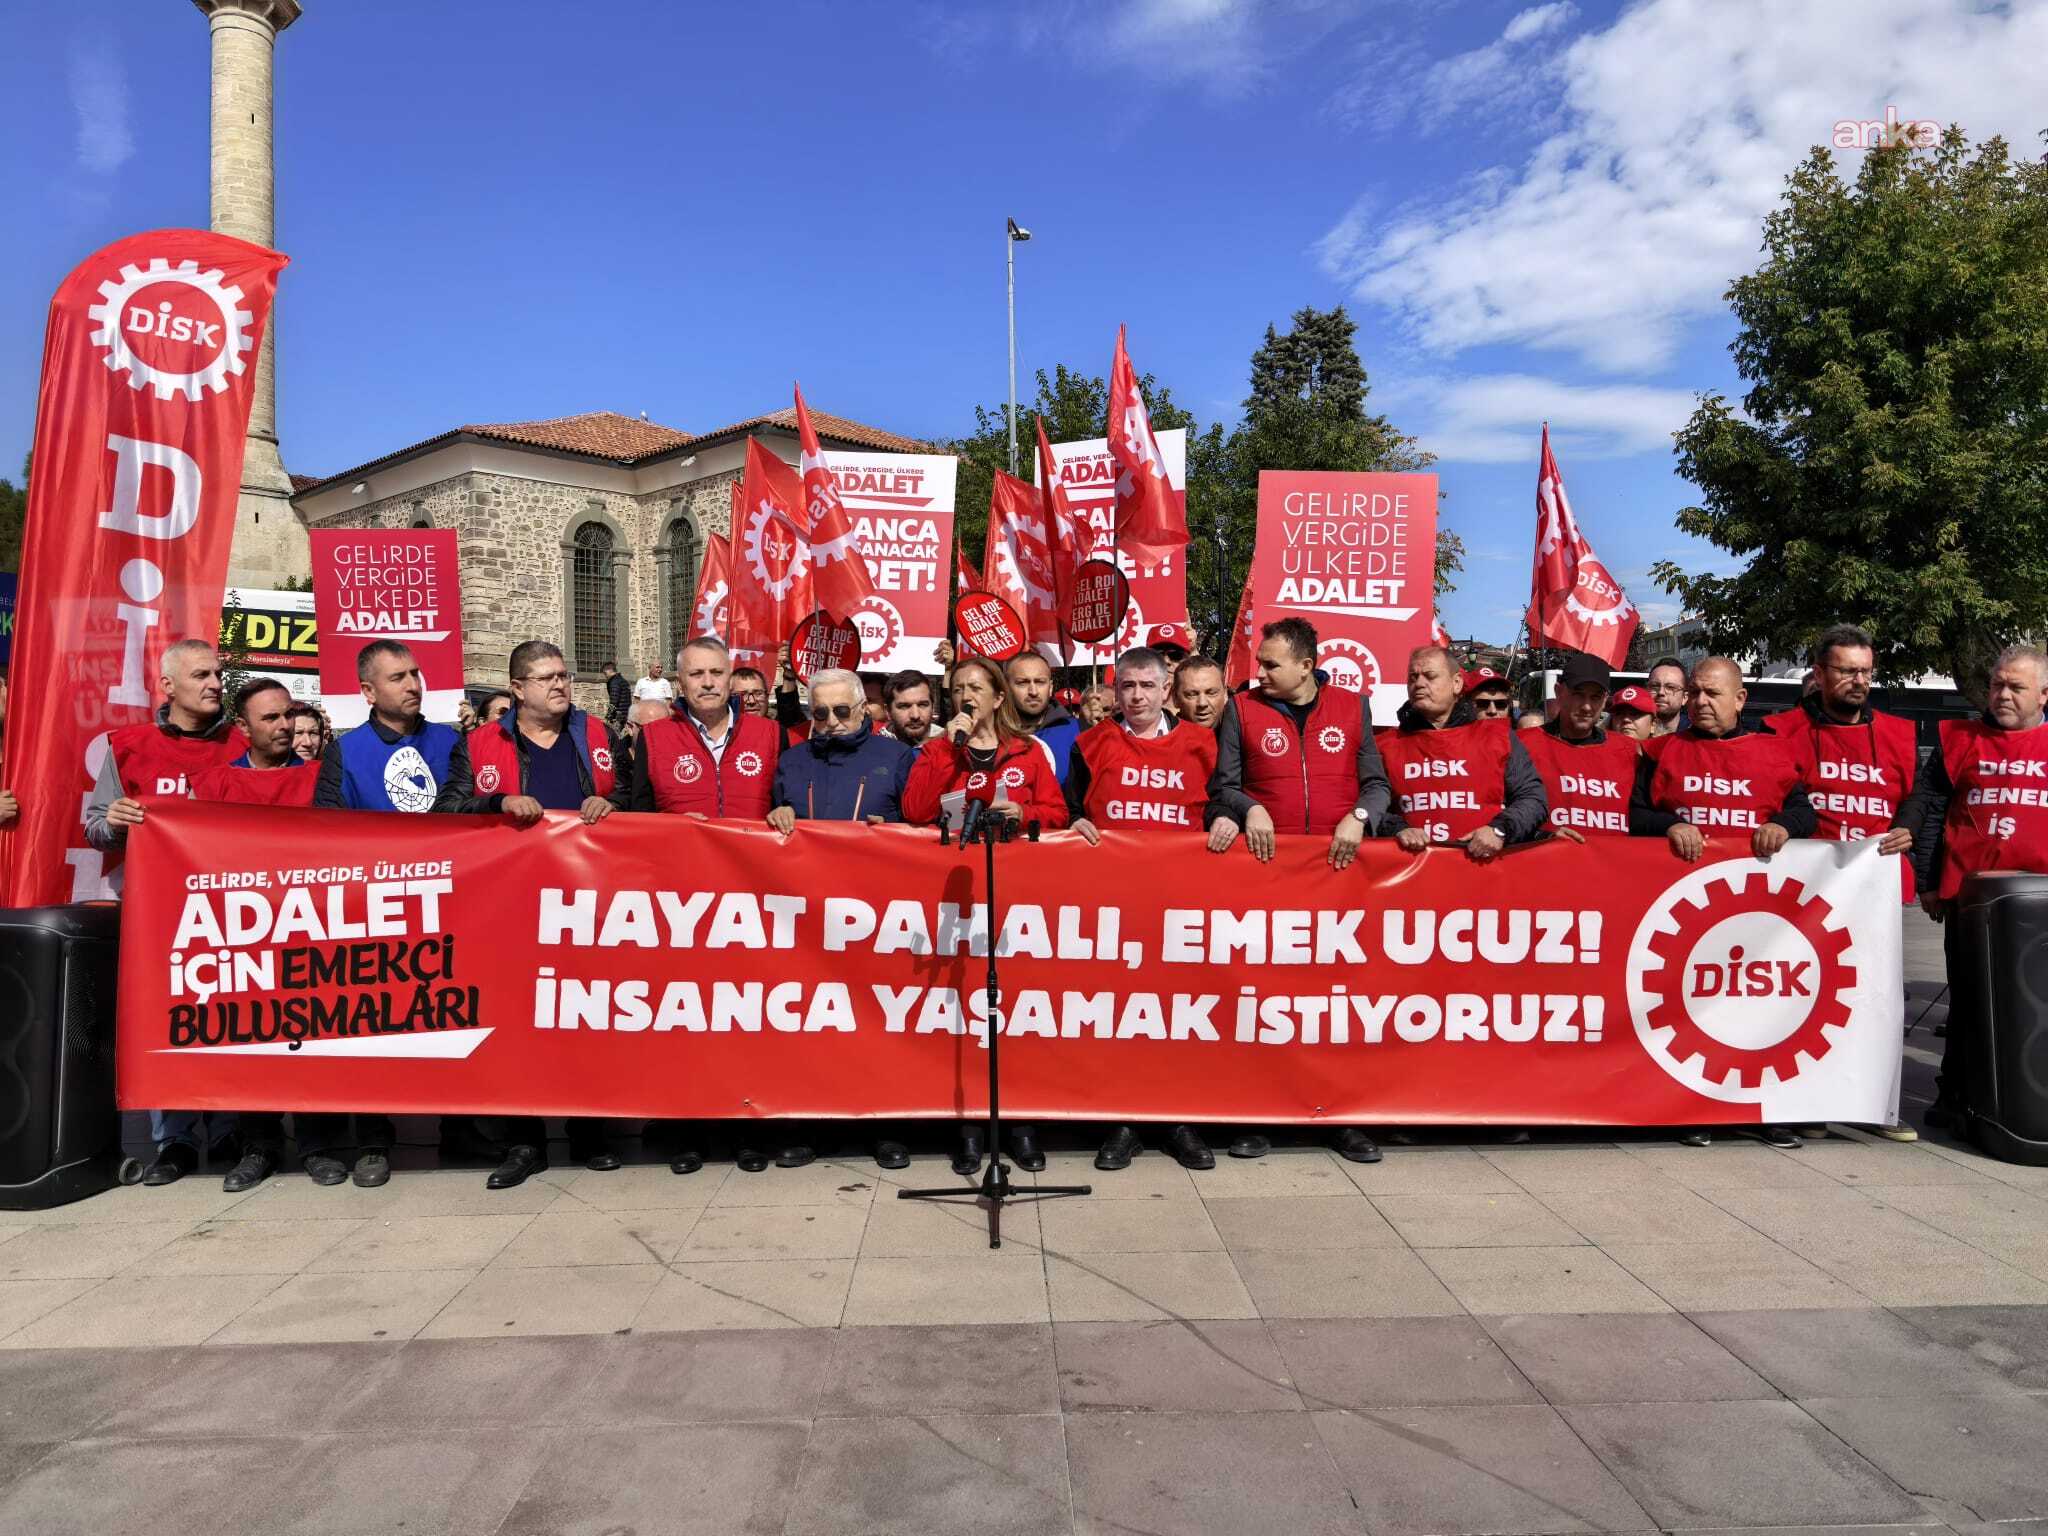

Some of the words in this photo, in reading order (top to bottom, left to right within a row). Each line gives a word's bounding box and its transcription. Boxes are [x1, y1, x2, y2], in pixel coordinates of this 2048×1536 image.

[849, 517, 940, 543] ANCA
[858, 542, 938, 559] ANACAK
[1282, 544, 1407, 576] ÜLKEDE
[337, 586, 438, 609] ÜLKEDE
[1276, 578, 1405, 605] ADALET
[336, 610, 439, 632] ADALET
[860, 621, 885, 639] İSK
[968, 611, 1003, 634] ADALET
[1332, 668, 1359, 686] İSK
[1121, 765, 1185, 790] DİSK
[1404, 757, 1469, 780] DİSK
[1820, 758, 1887, 786] DİSK
[1559, 773, 1621, 799] DİSK
[1683, 772, 1752, 797] DİSK
[1400, 791, 1481, 813] GENEL
[1807, 791, 1893, 818] GENEL
[1967, 787, 2048, 808] GENEL
[1106, 800, 1190, 825] GENEL
[1550, 807, 1630, 833] GENEL
[1675, 806, 1761, 829] GENEL
[374, 860, 453, 880] ÜLKEDE
[171, 878, 453, 949] ADALET
[537, 887, 806, 949] HAYAT
[823, 896, 1143, 970] PAHALI,
[1161, 908, 1367, 965] EMEK
[1382, 908, 1603, 965] UCUZ!
[1690, 944, 1812, 998] DİSK
[168, 985, 480, 1051] BULUŞMALARI
[534, 967, 857, 1033] İNSANCA
[871, 982, 1221, 1049] YAŞAMAK
[1234, 985, 1606, 1045] İSTİYORUZ!
